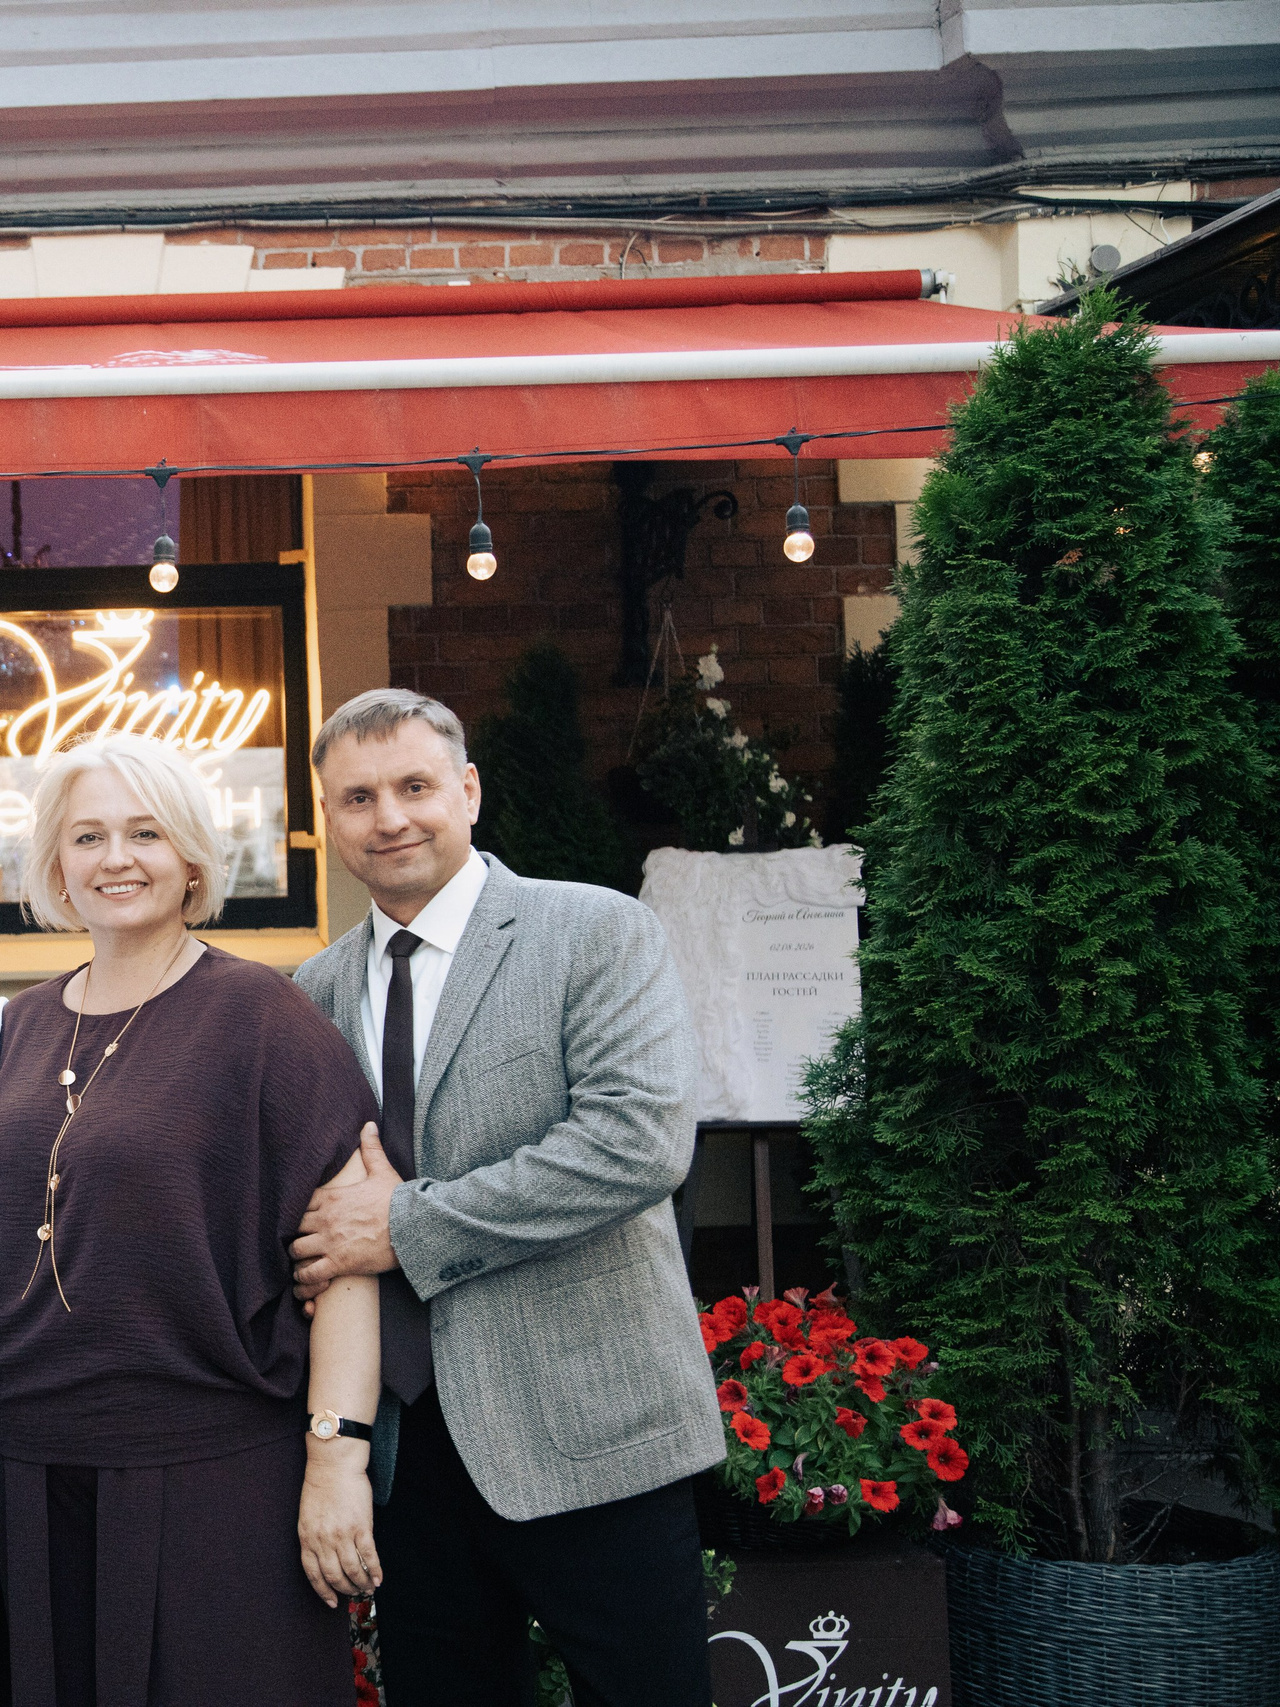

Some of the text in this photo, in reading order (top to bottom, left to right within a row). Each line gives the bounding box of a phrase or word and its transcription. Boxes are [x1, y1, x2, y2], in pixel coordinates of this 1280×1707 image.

[746, 972, 844, 982] ПЛАН РАССАДКИ
[772, 985, 818, 996] ГОСТЕЙ
